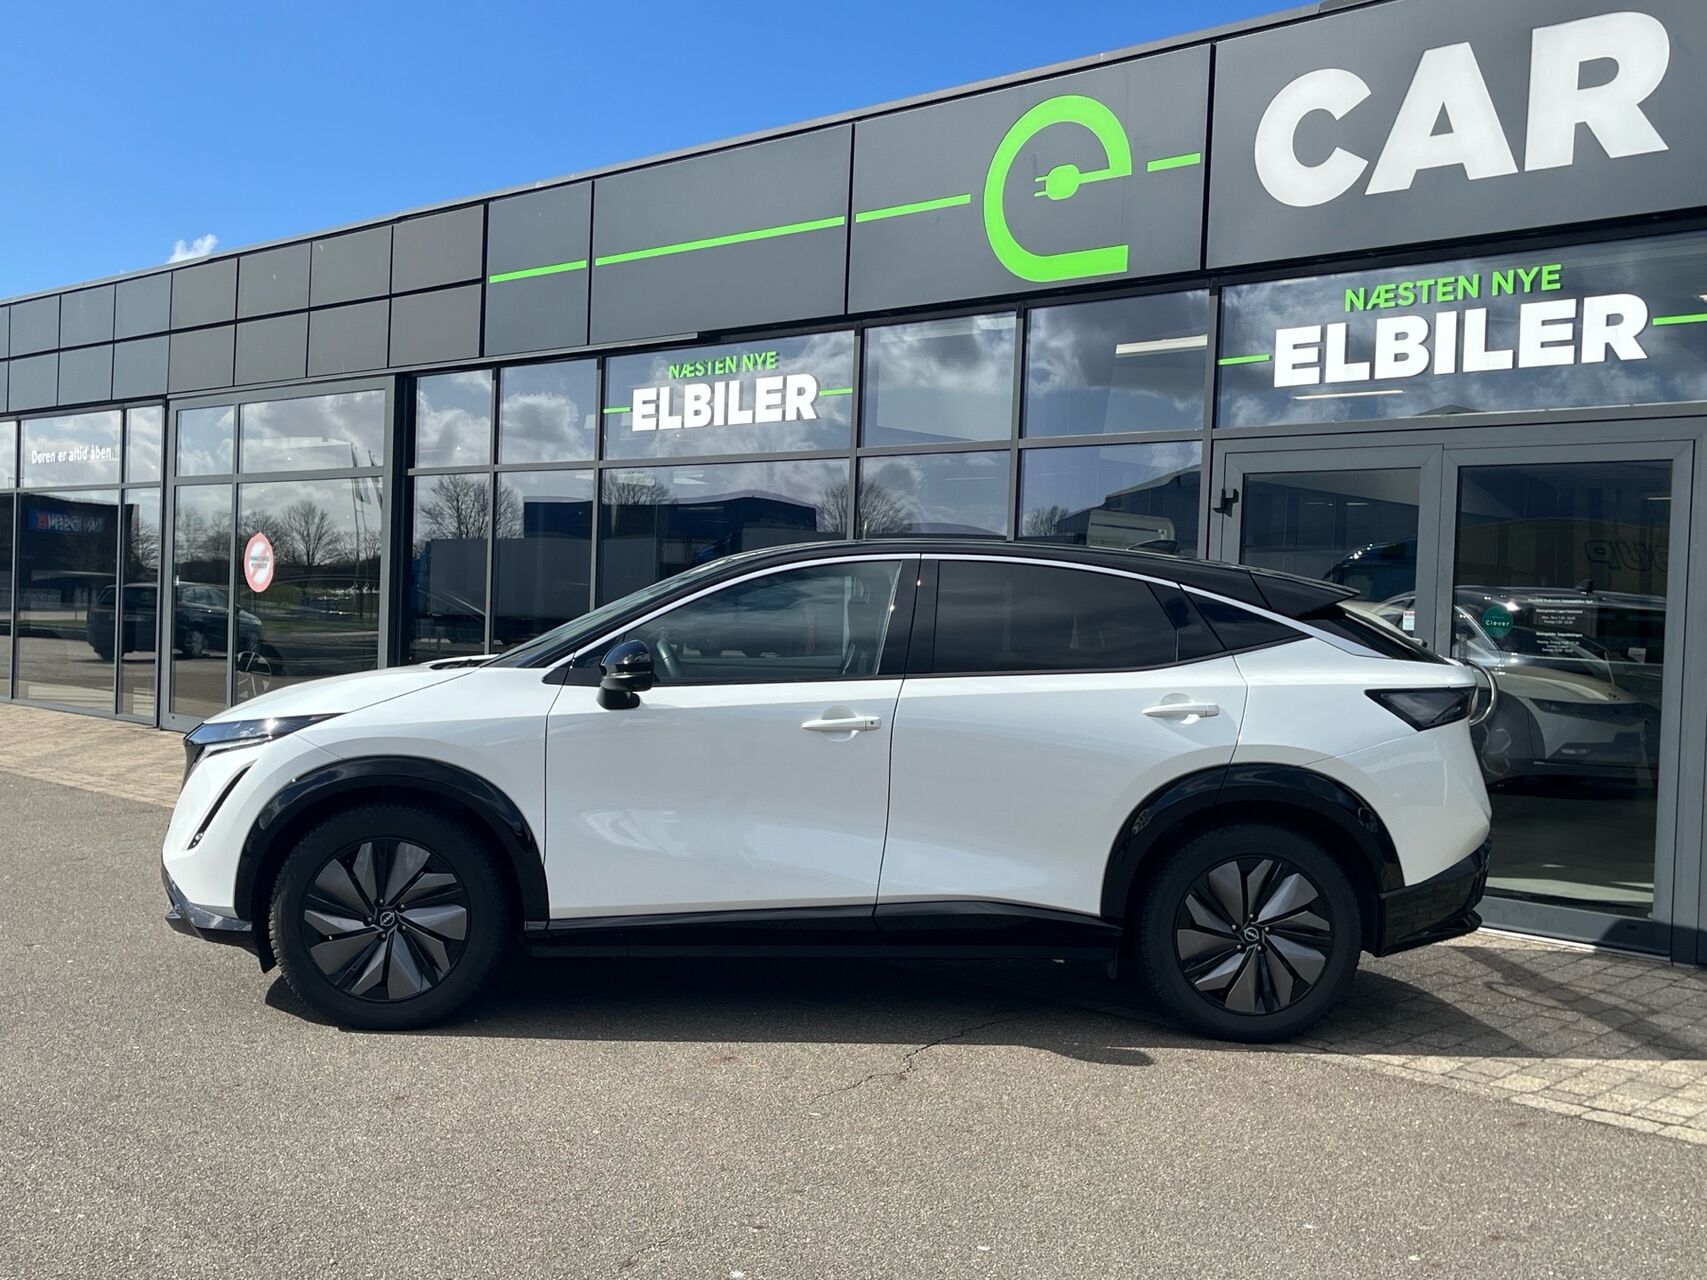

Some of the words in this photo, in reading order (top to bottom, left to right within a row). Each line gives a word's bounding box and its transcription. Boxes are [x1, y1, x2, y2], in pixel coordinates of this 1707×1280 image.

[1255, 12, 1670, 208] CAR
[1344, 273, 1480, 312] NÆSTEN
[1491, 263, 1562, 297] NYE
[1274, 293, 1649, 388] ELBILER
[668, 355, 737, 380] NÆSTEN
[742, 351, 777, 371] NYE
[631, 373, 819, 432] ELBILER
[58, 451, 67, 463] er
[68, 446, 87, 462] altid
[90, 444, 112, 460] åben
[1485, 619, 1510, 627] Clever
